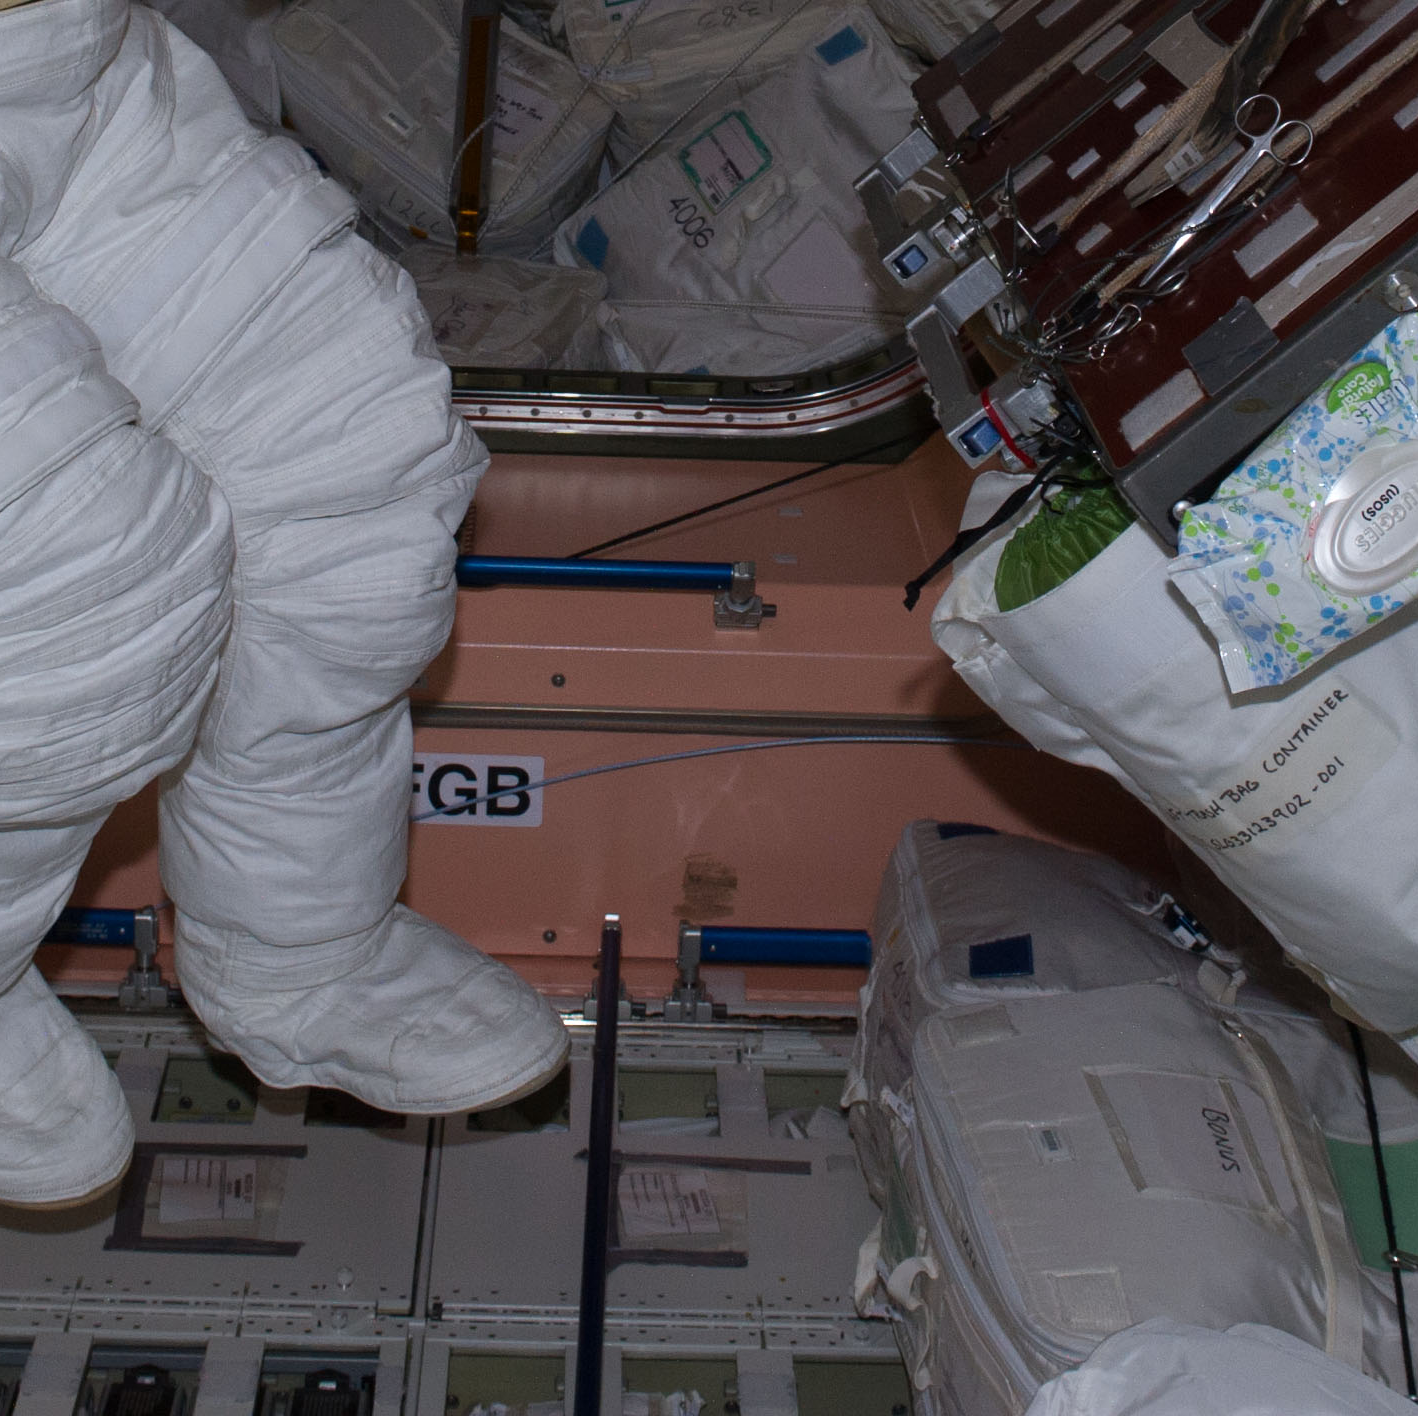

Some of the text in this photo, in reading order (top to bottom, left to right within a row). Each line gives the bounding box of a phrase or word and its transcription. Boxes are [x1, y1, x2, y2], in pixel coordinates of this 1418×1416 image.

[670, 196, 715, 248] 4006
[1337, 373, 1368, 398] Care
[1361, 484, 1400, 522] (USOS)
[1219, 779, 1259, 804] BAG
[1262, 688, 1348, 776] CONTAINER
[1200, 1107, 1241, 1174] BONUS
